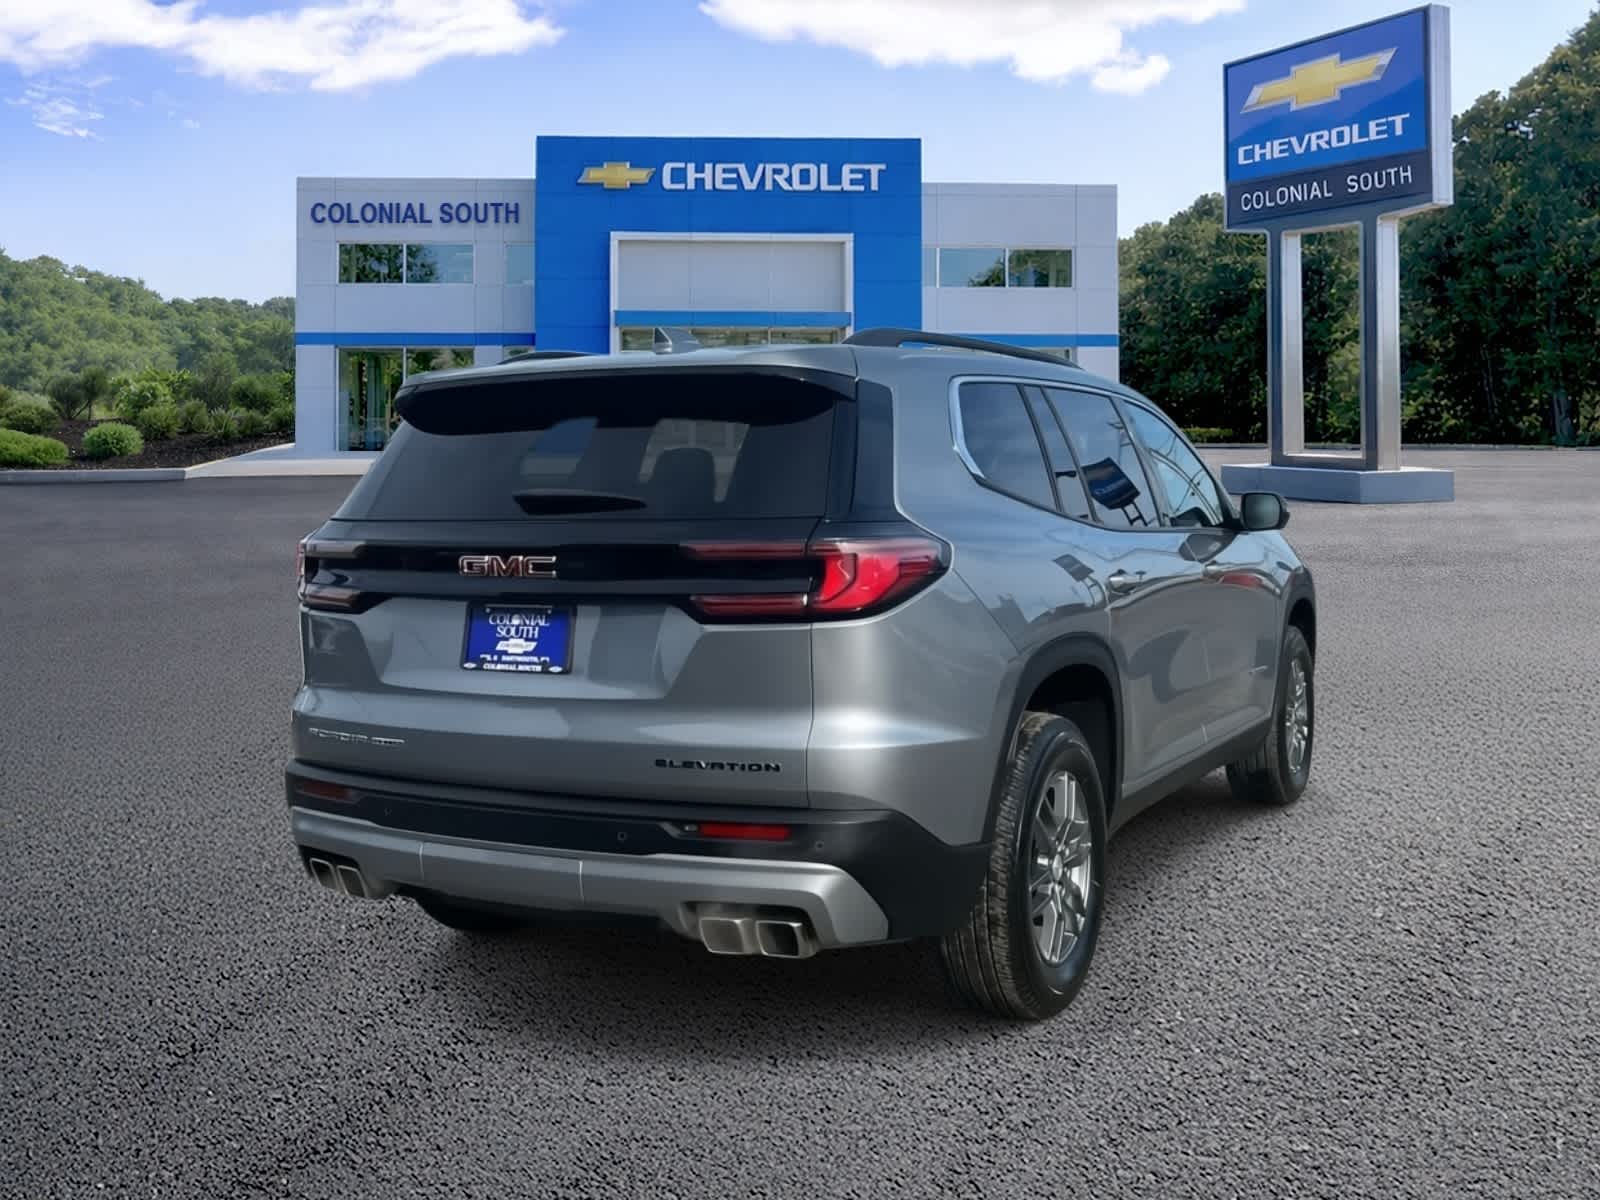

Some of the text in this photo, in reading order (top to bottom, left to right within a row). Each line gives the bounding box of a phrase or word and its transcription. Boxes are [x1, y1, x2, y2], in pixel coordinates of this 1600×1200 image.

[1237, 113, 1410, 165] CHEVROLET
[662, 162, 886, 191] CHEVROLET
[1240, 165, 1412, 212] COLONIAL SOUTH
[310, 202, 520, 223] COLONIAL SOUTH
[459, 555, 557, 578] GMC
[495, 626, 540, 639] SOUTH
[655, 759, 781, 772] ELEVATION
